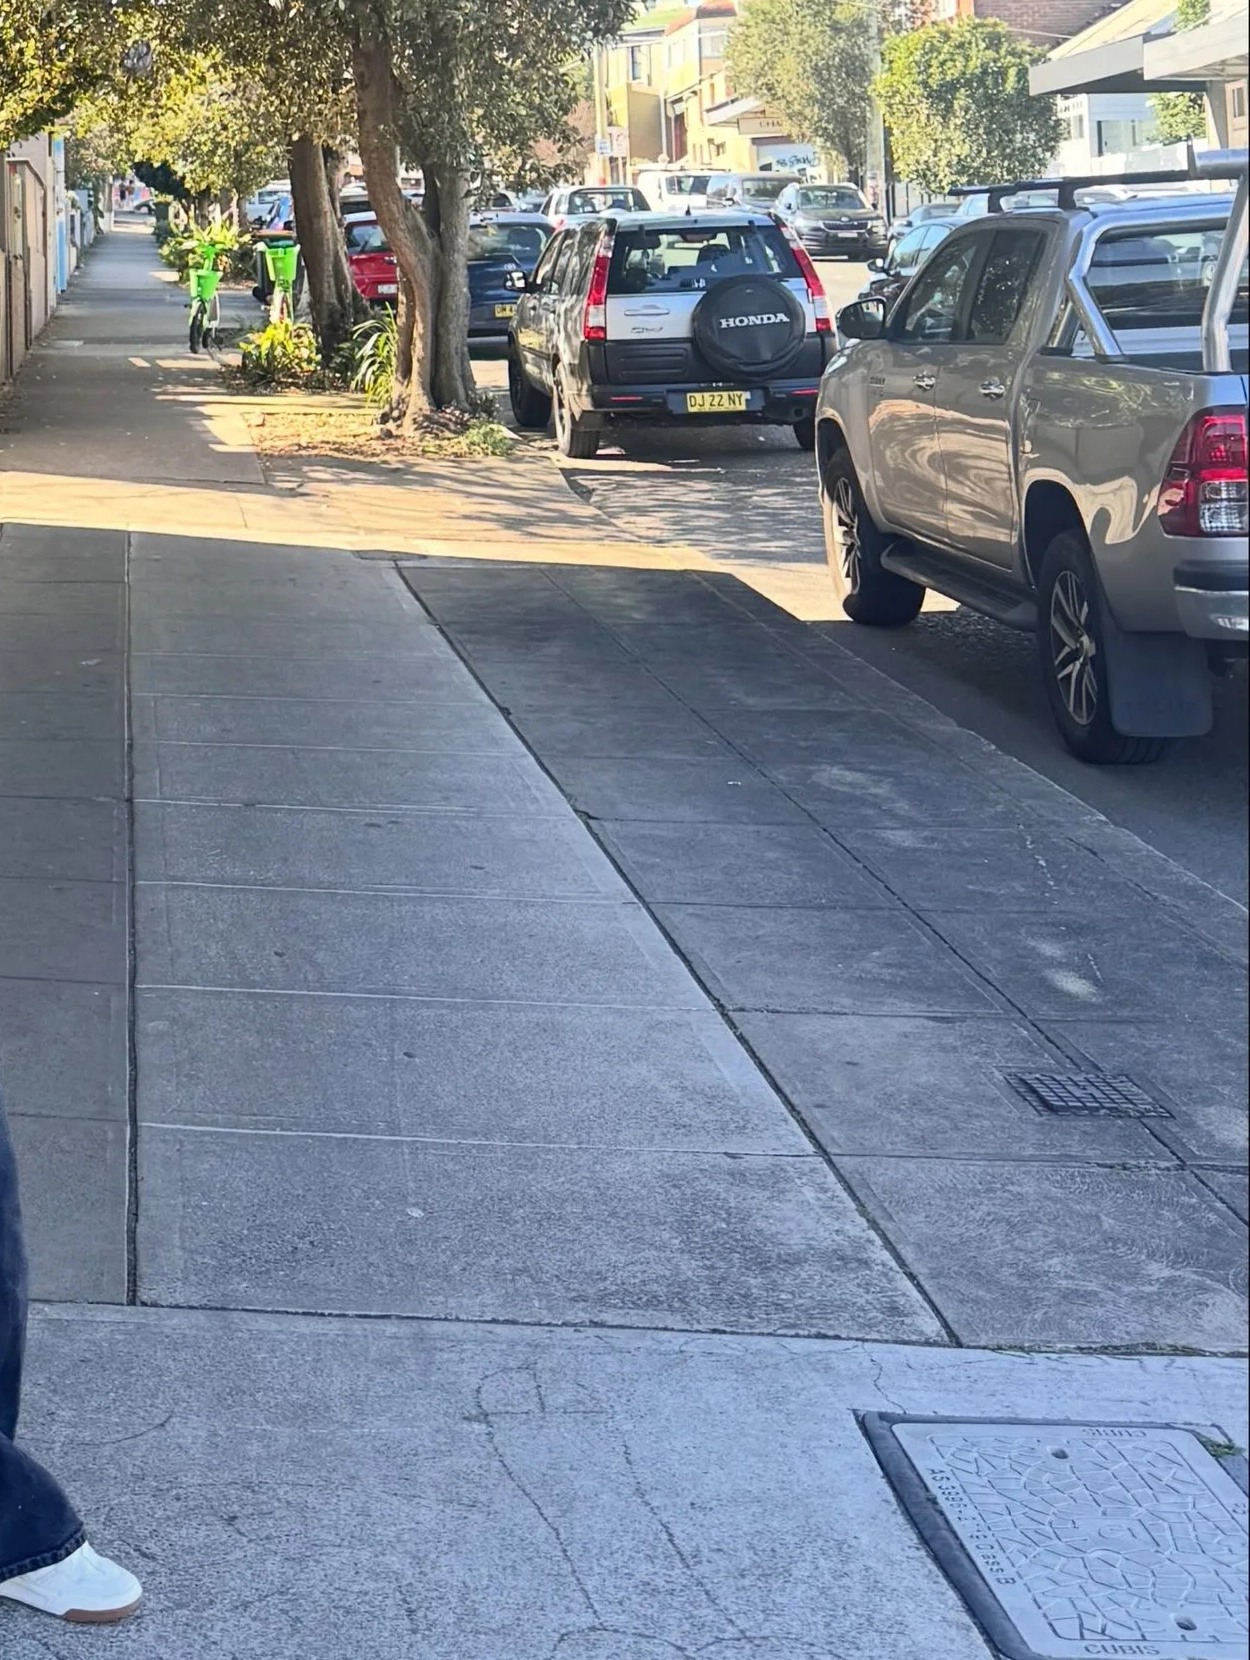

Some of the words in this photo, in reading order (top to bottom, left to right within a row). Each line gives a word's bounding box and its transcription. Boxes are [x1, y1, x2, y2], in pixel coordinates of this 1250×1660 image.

[719, 313, 790, 329] HONDA
[689, 395, 705, 408] DJ
[709, 394, 724, 407] 22
[728, 392, 743, 406] NY
[1084, 1644, 1161, 1656] CUBIS
